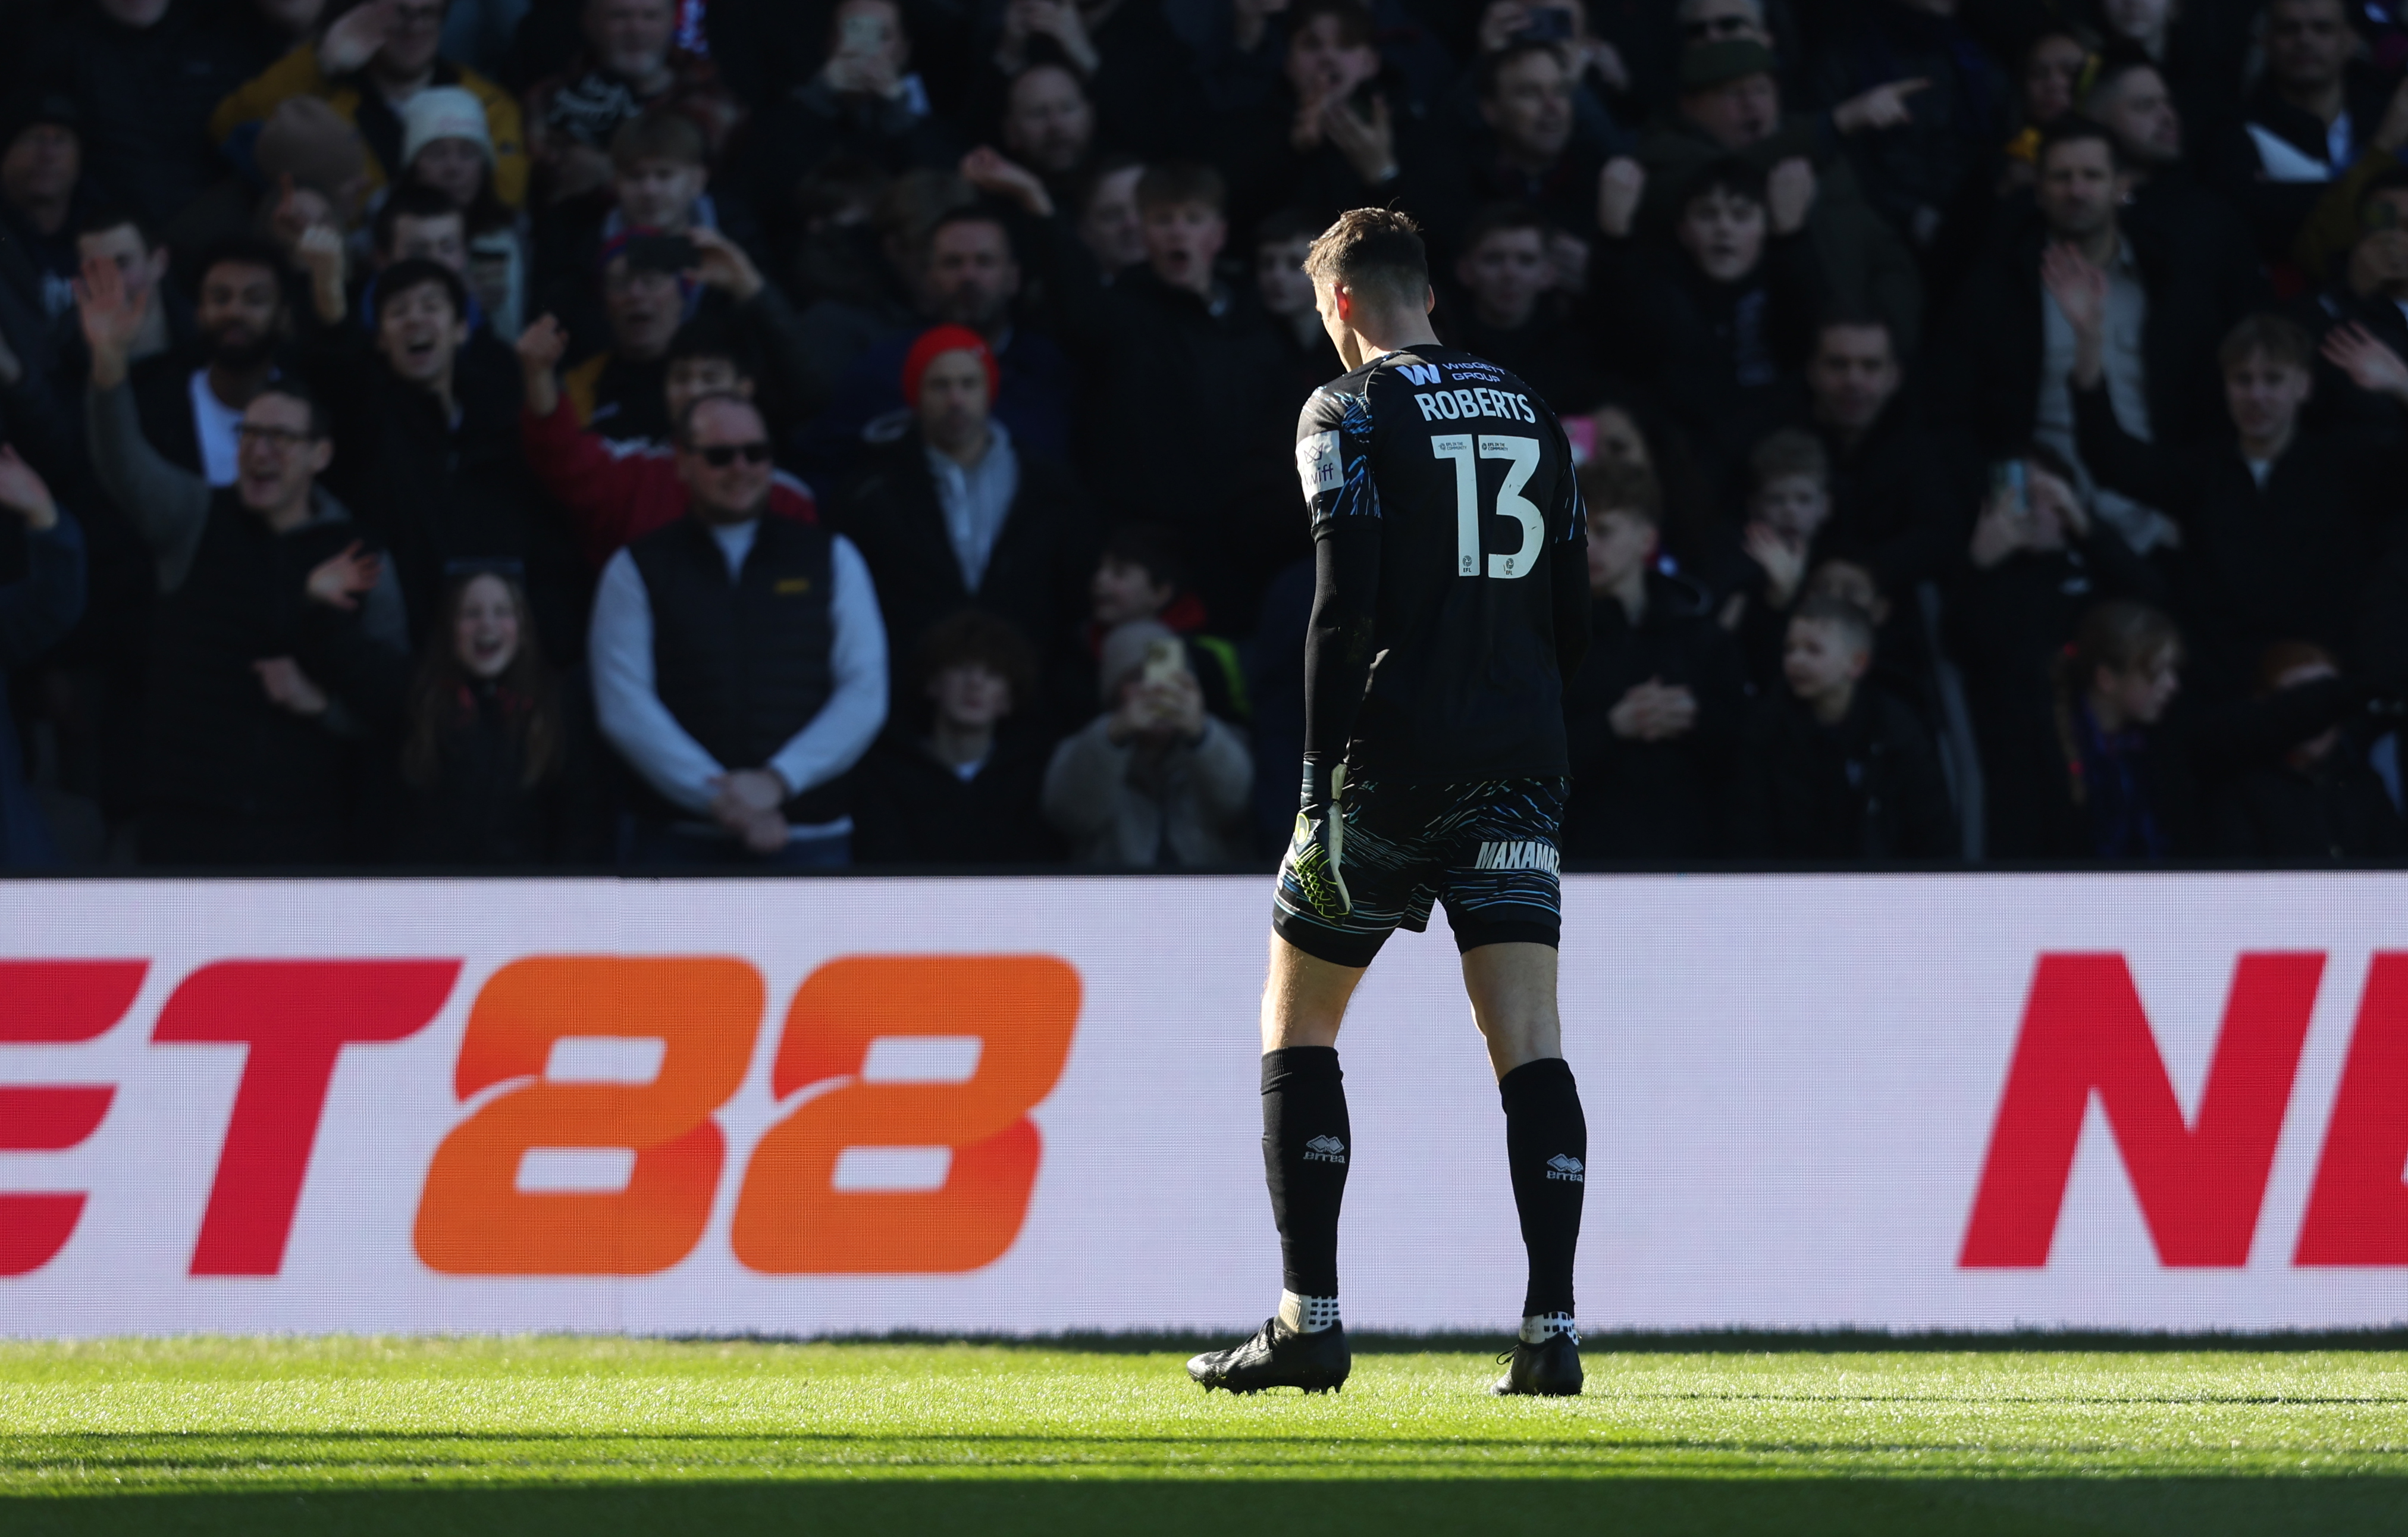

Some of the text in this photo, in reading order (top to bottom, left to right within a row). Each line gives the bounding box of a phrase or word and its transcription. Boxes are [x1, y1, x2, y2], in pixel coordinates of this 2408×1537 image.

[1442, 362, 1506, 375] WIGGETT
[1451, 372, 1501, 383] GROUP
[1414, 387, 1536, 424] ROBERTS
[1431, 433, 1545, 579] 13
